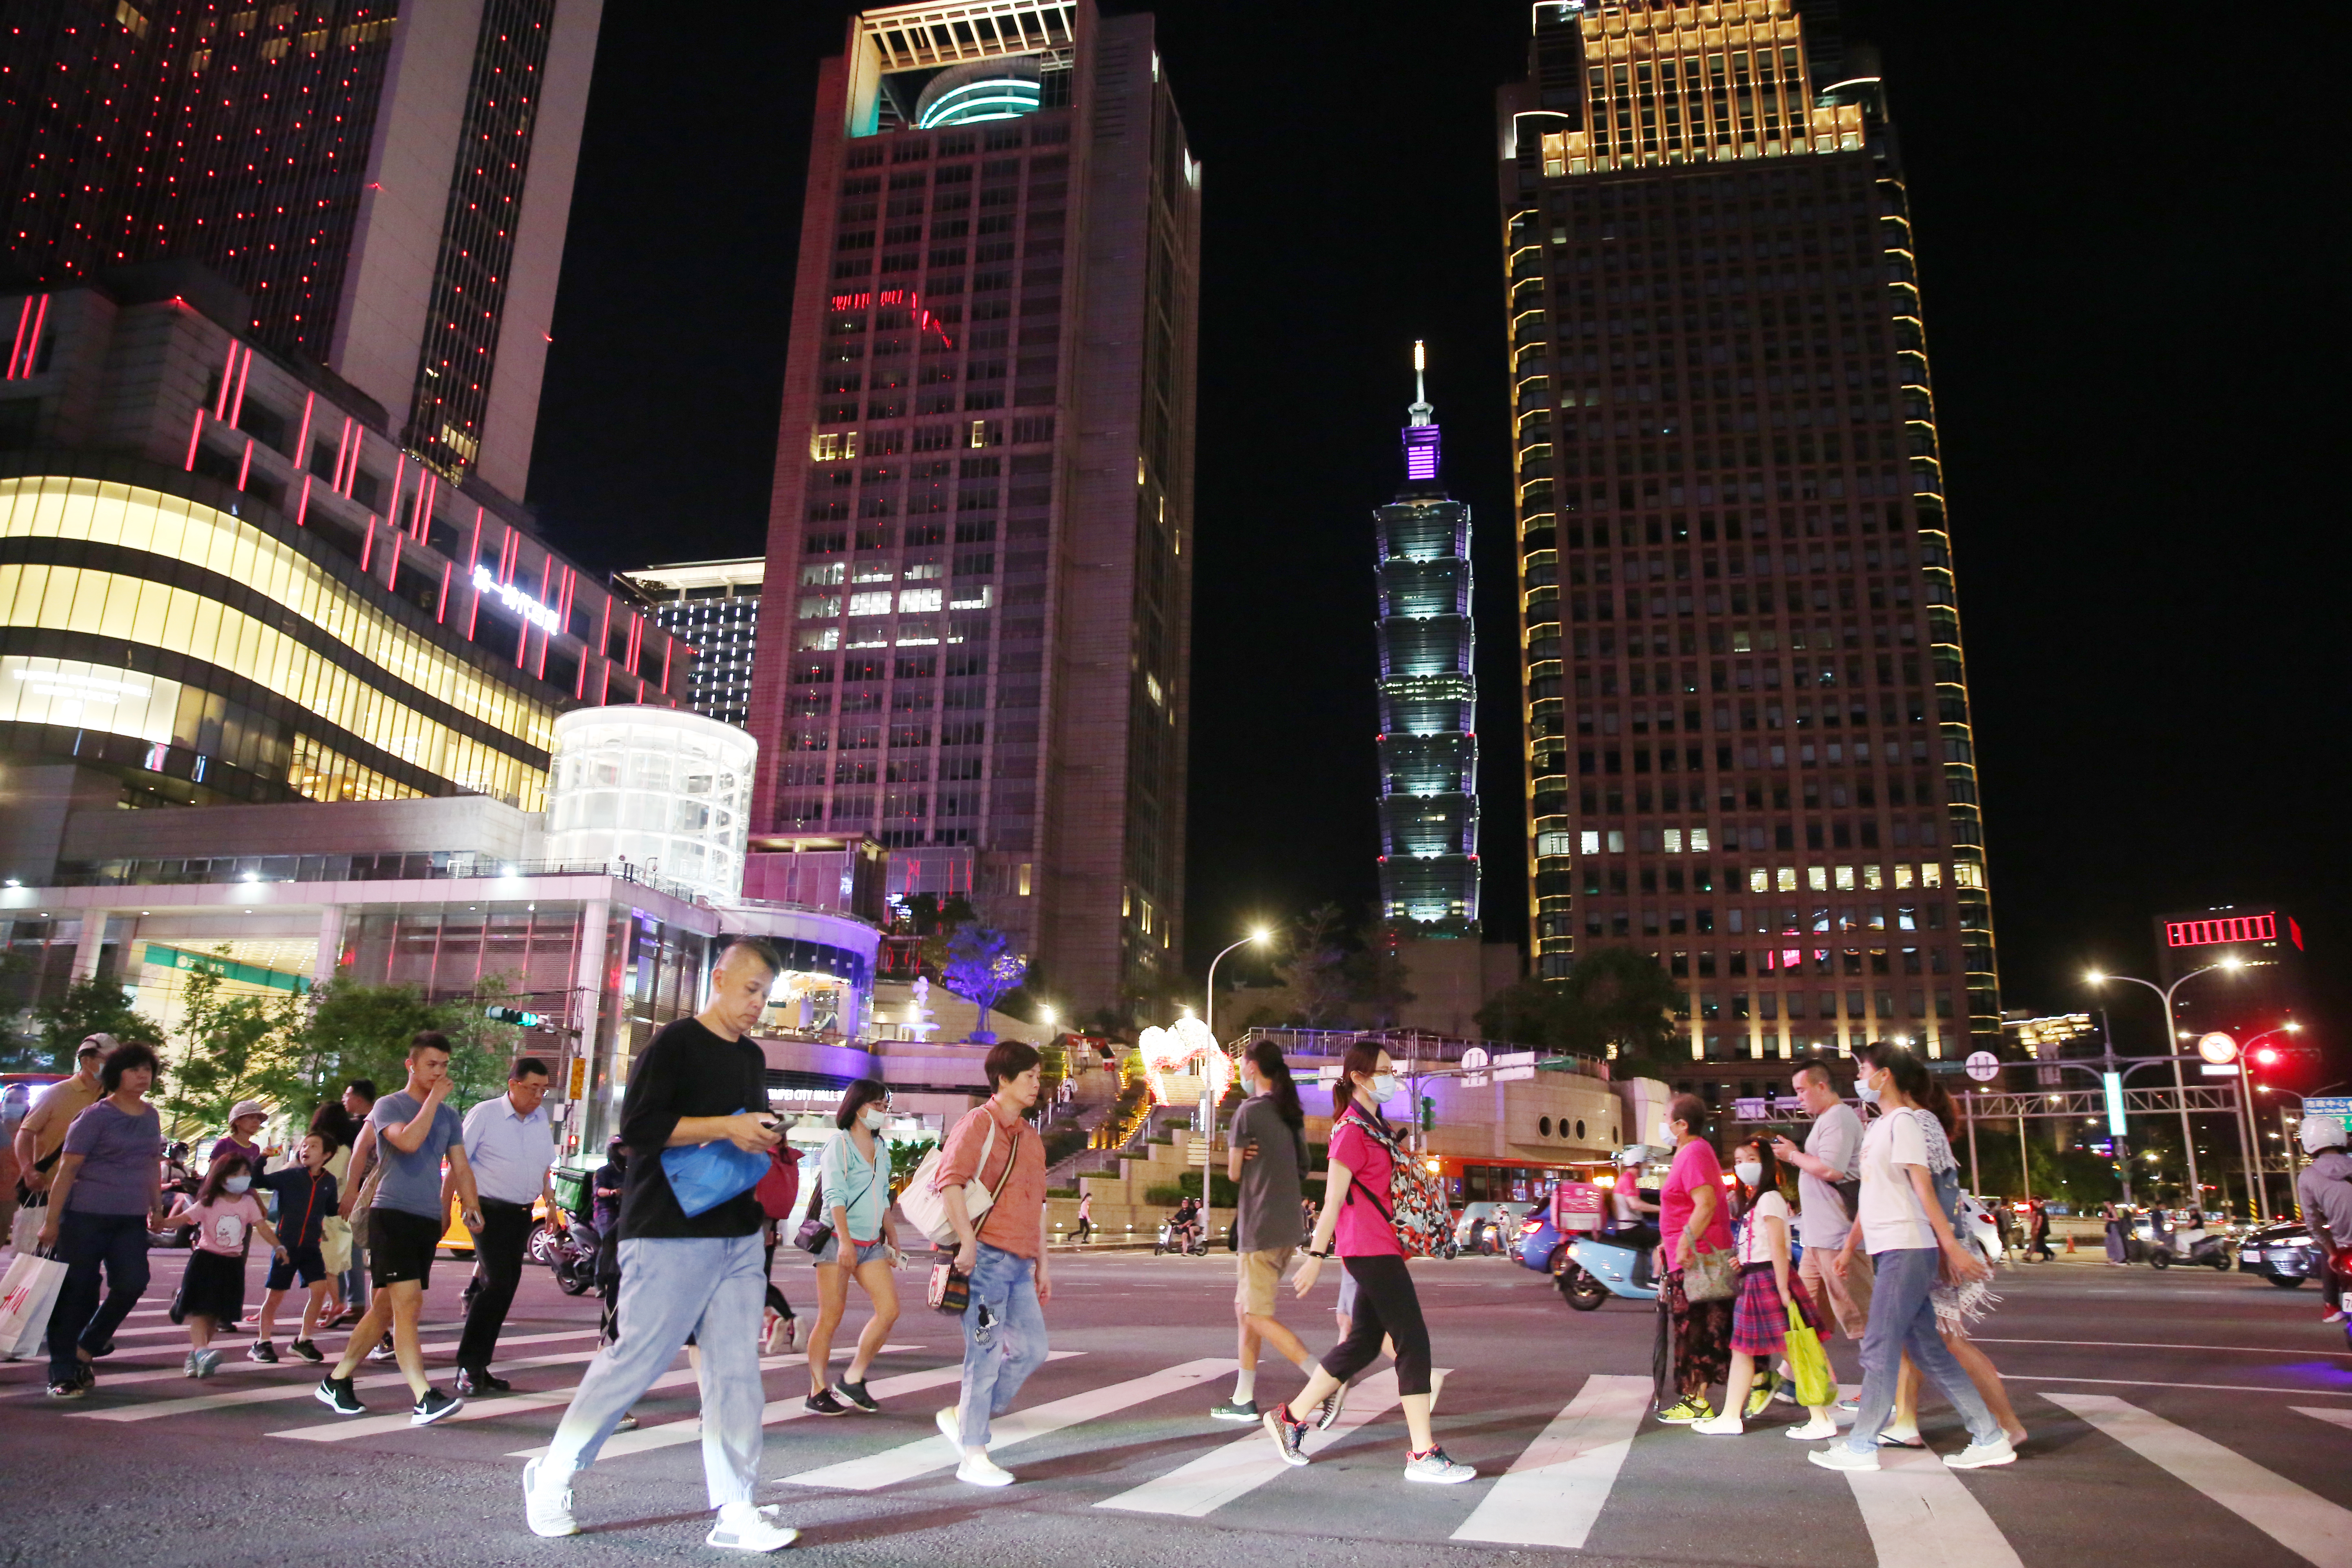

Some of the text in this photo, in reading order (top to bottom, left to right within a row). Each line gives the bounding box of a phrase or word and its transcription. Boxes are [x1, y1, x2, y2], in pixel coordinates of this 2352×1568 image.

[767, 1089, 793, 1100] TAIPEI
[794, 1089, 813, 1101] CITY
[813, 1090, 836, 1101] HALL
